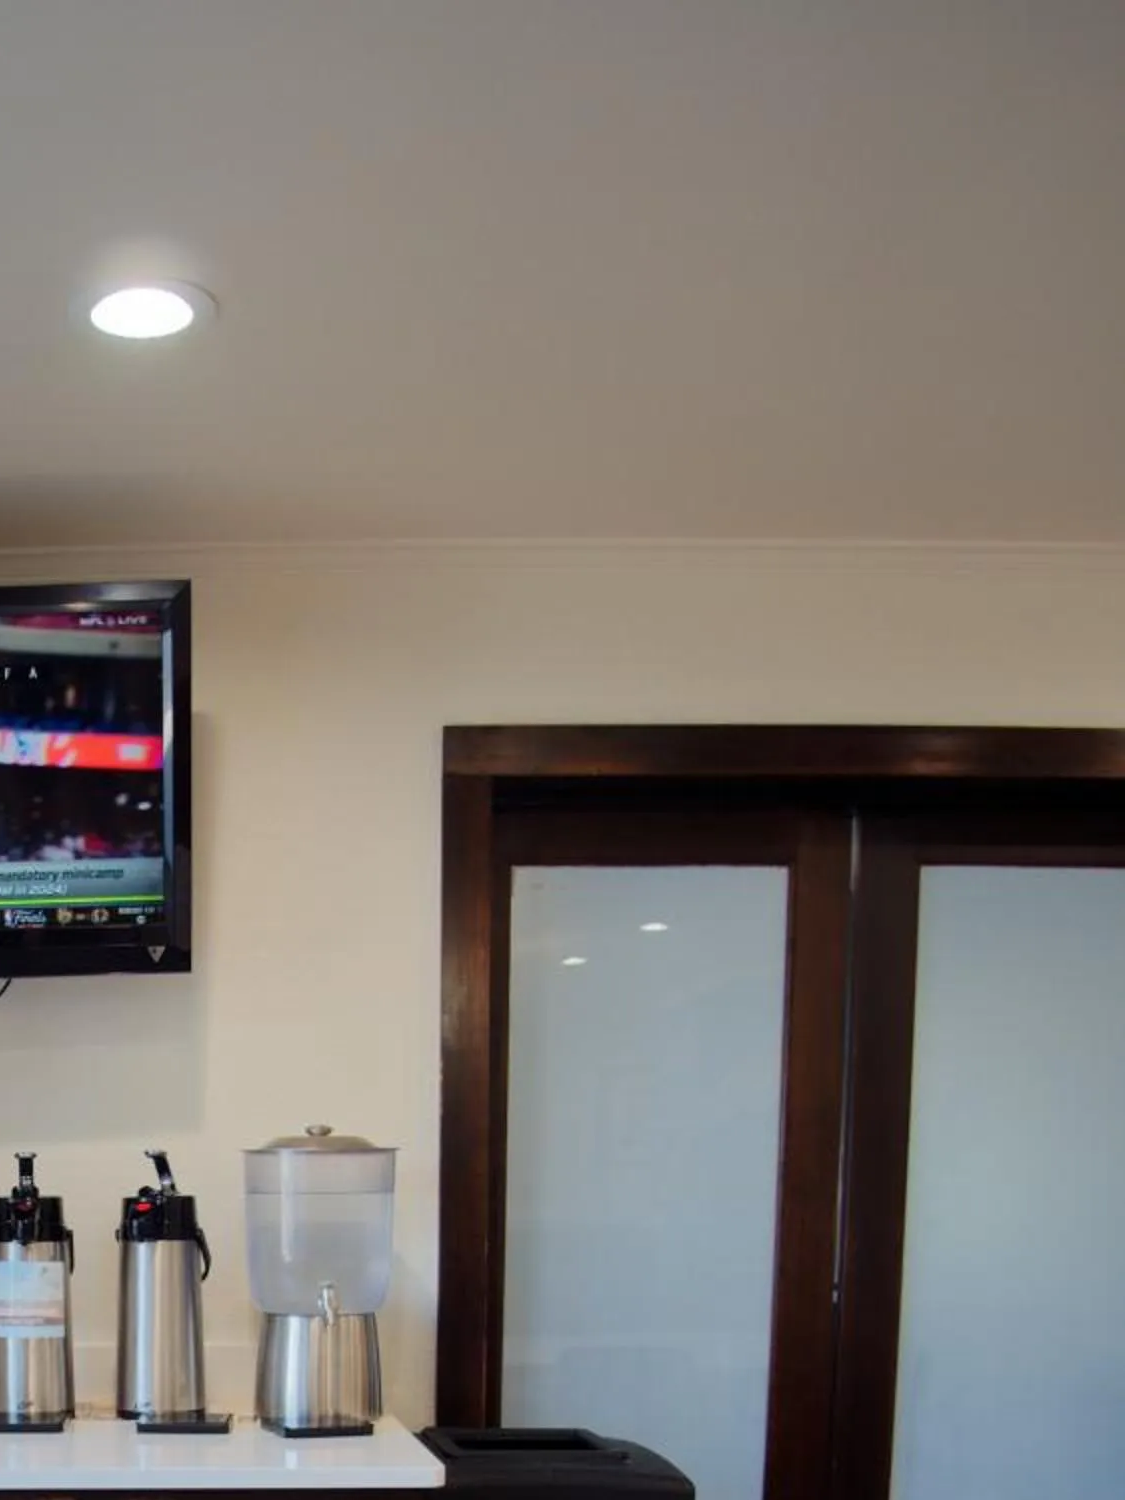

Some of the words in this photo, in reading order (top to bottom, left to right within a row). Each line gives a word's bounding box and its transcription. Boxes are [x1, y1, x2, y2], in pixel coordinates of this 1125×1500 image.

[118, 615, 148, 625] LIVE
[28, 666, 39, 679] A
[62, 865, 125, 880] minicamp
